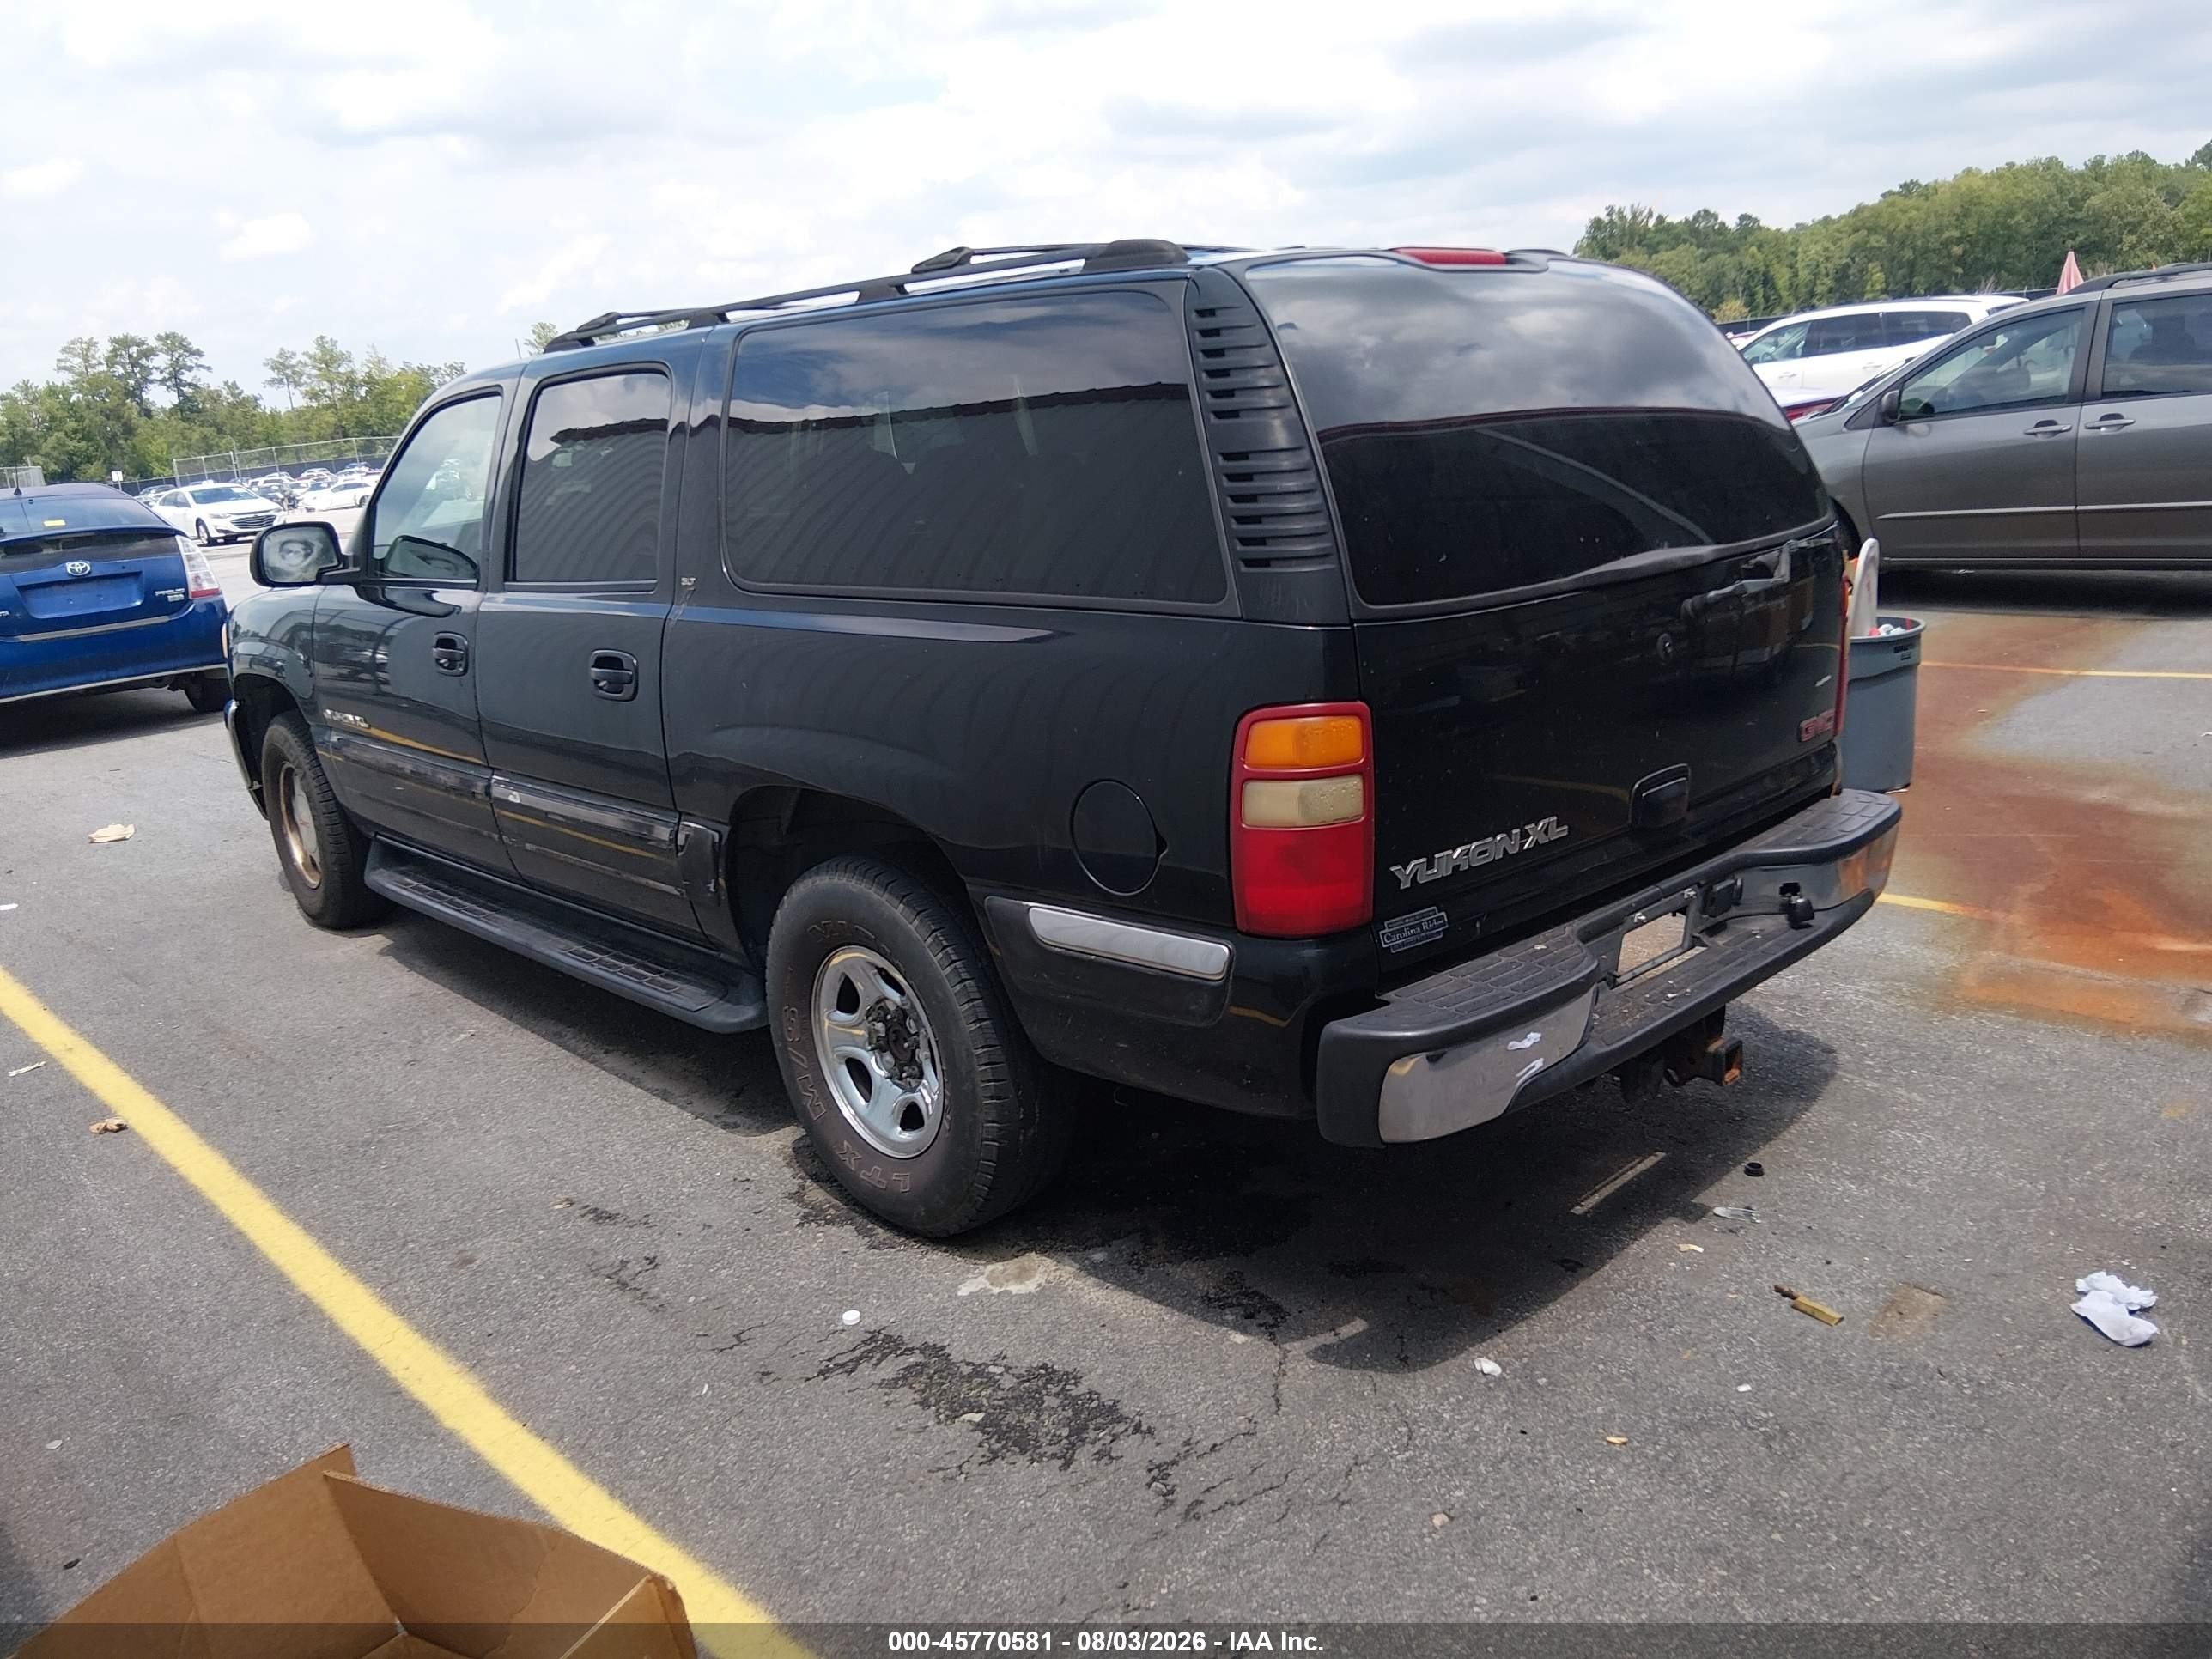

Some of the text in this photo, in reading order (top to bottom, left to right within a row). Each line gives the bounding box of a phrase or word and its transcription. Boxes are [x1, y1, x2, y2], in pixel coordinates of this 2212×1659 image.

[1389, 816, 1569, 890] YUKON XL
[837, 1139, 910, 1193] LTX
